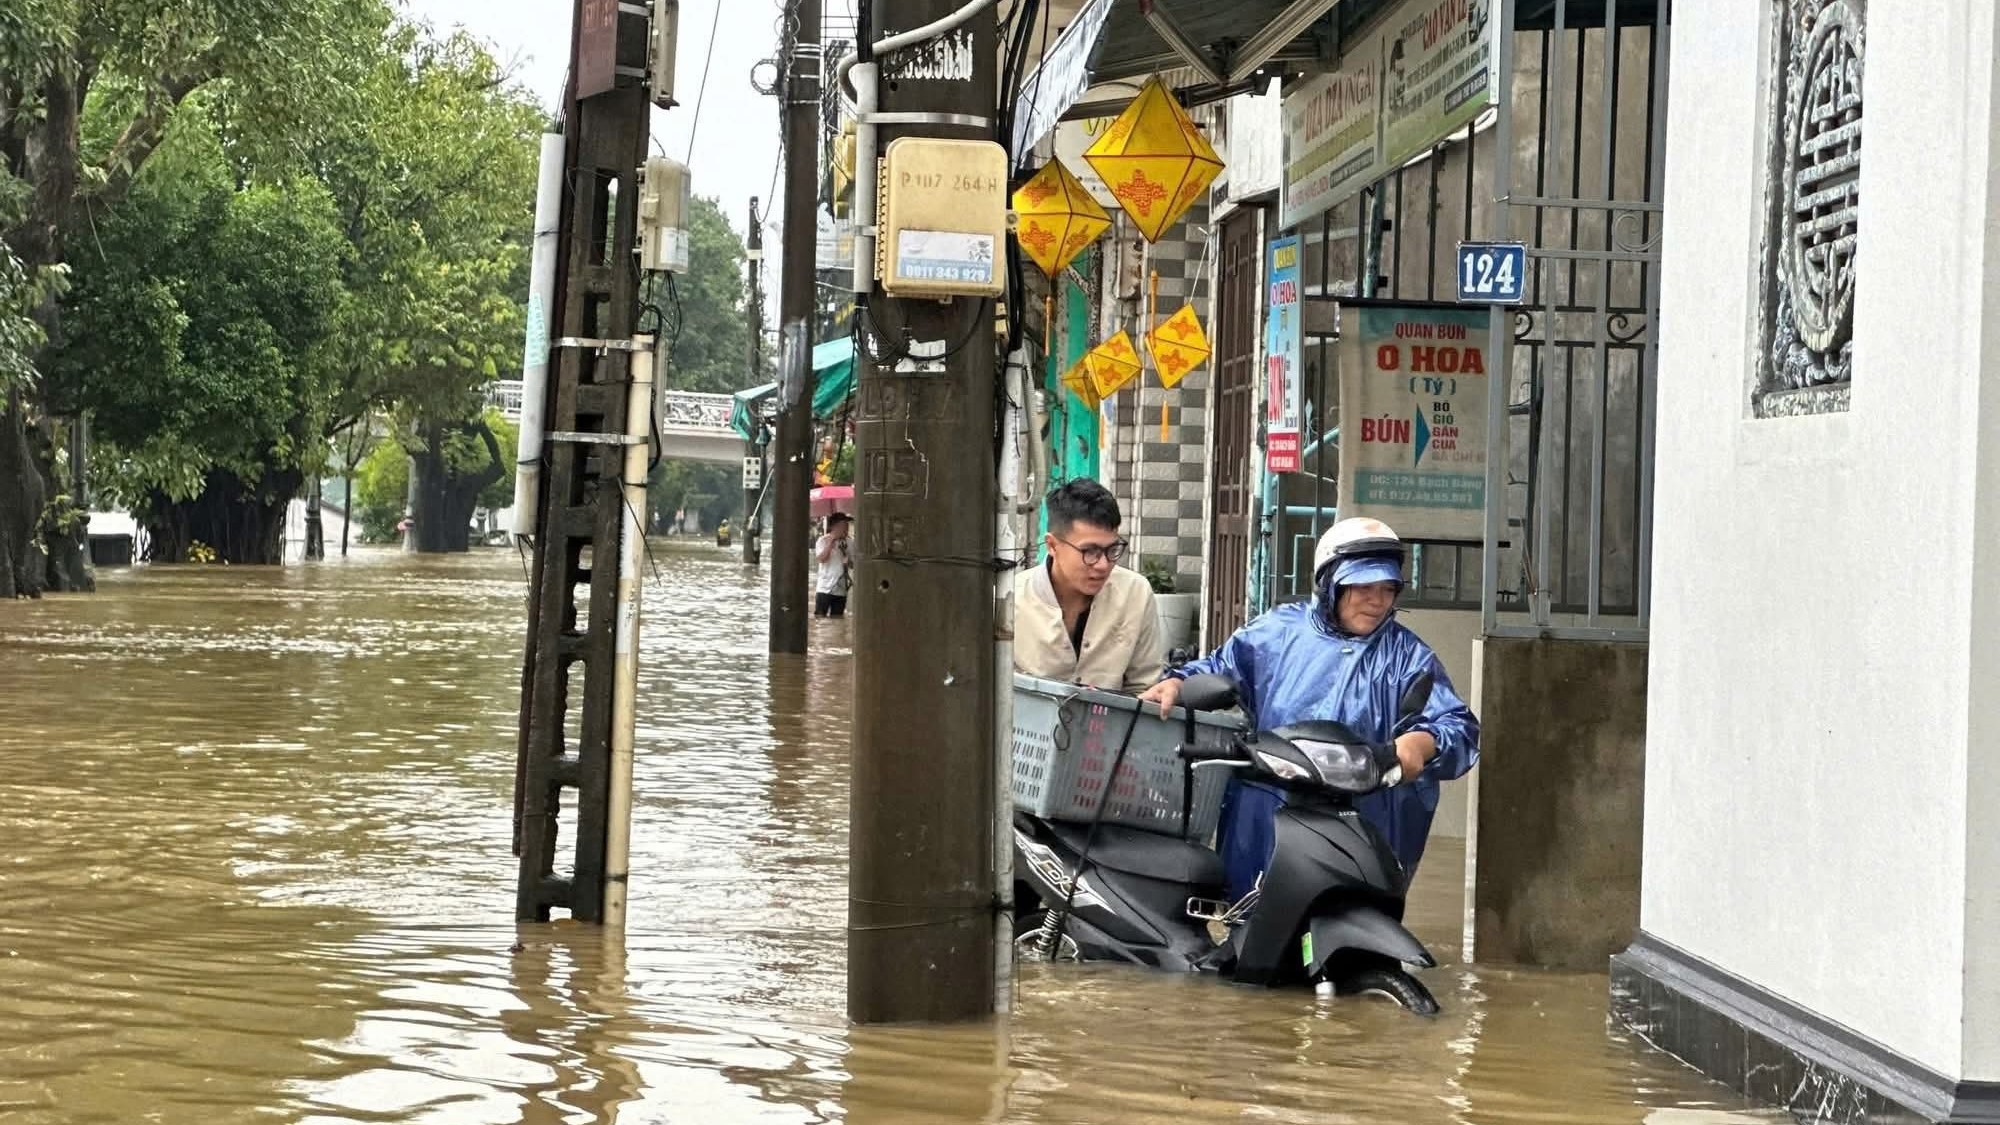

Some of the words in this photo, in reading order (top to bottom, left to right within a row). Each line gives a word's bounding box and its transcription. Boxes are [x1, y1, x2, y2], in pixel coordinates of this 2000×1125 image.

[1463, 252, 1515, 294] 124
[1279, 280, 1297, 304] HOA
[1377, 344, 1400, 371] O
[1410, 345, 1485, 375] HOA
[1360, 413, 1411, 444] BÚN
[1431, 438, 1457, 450] CUA
